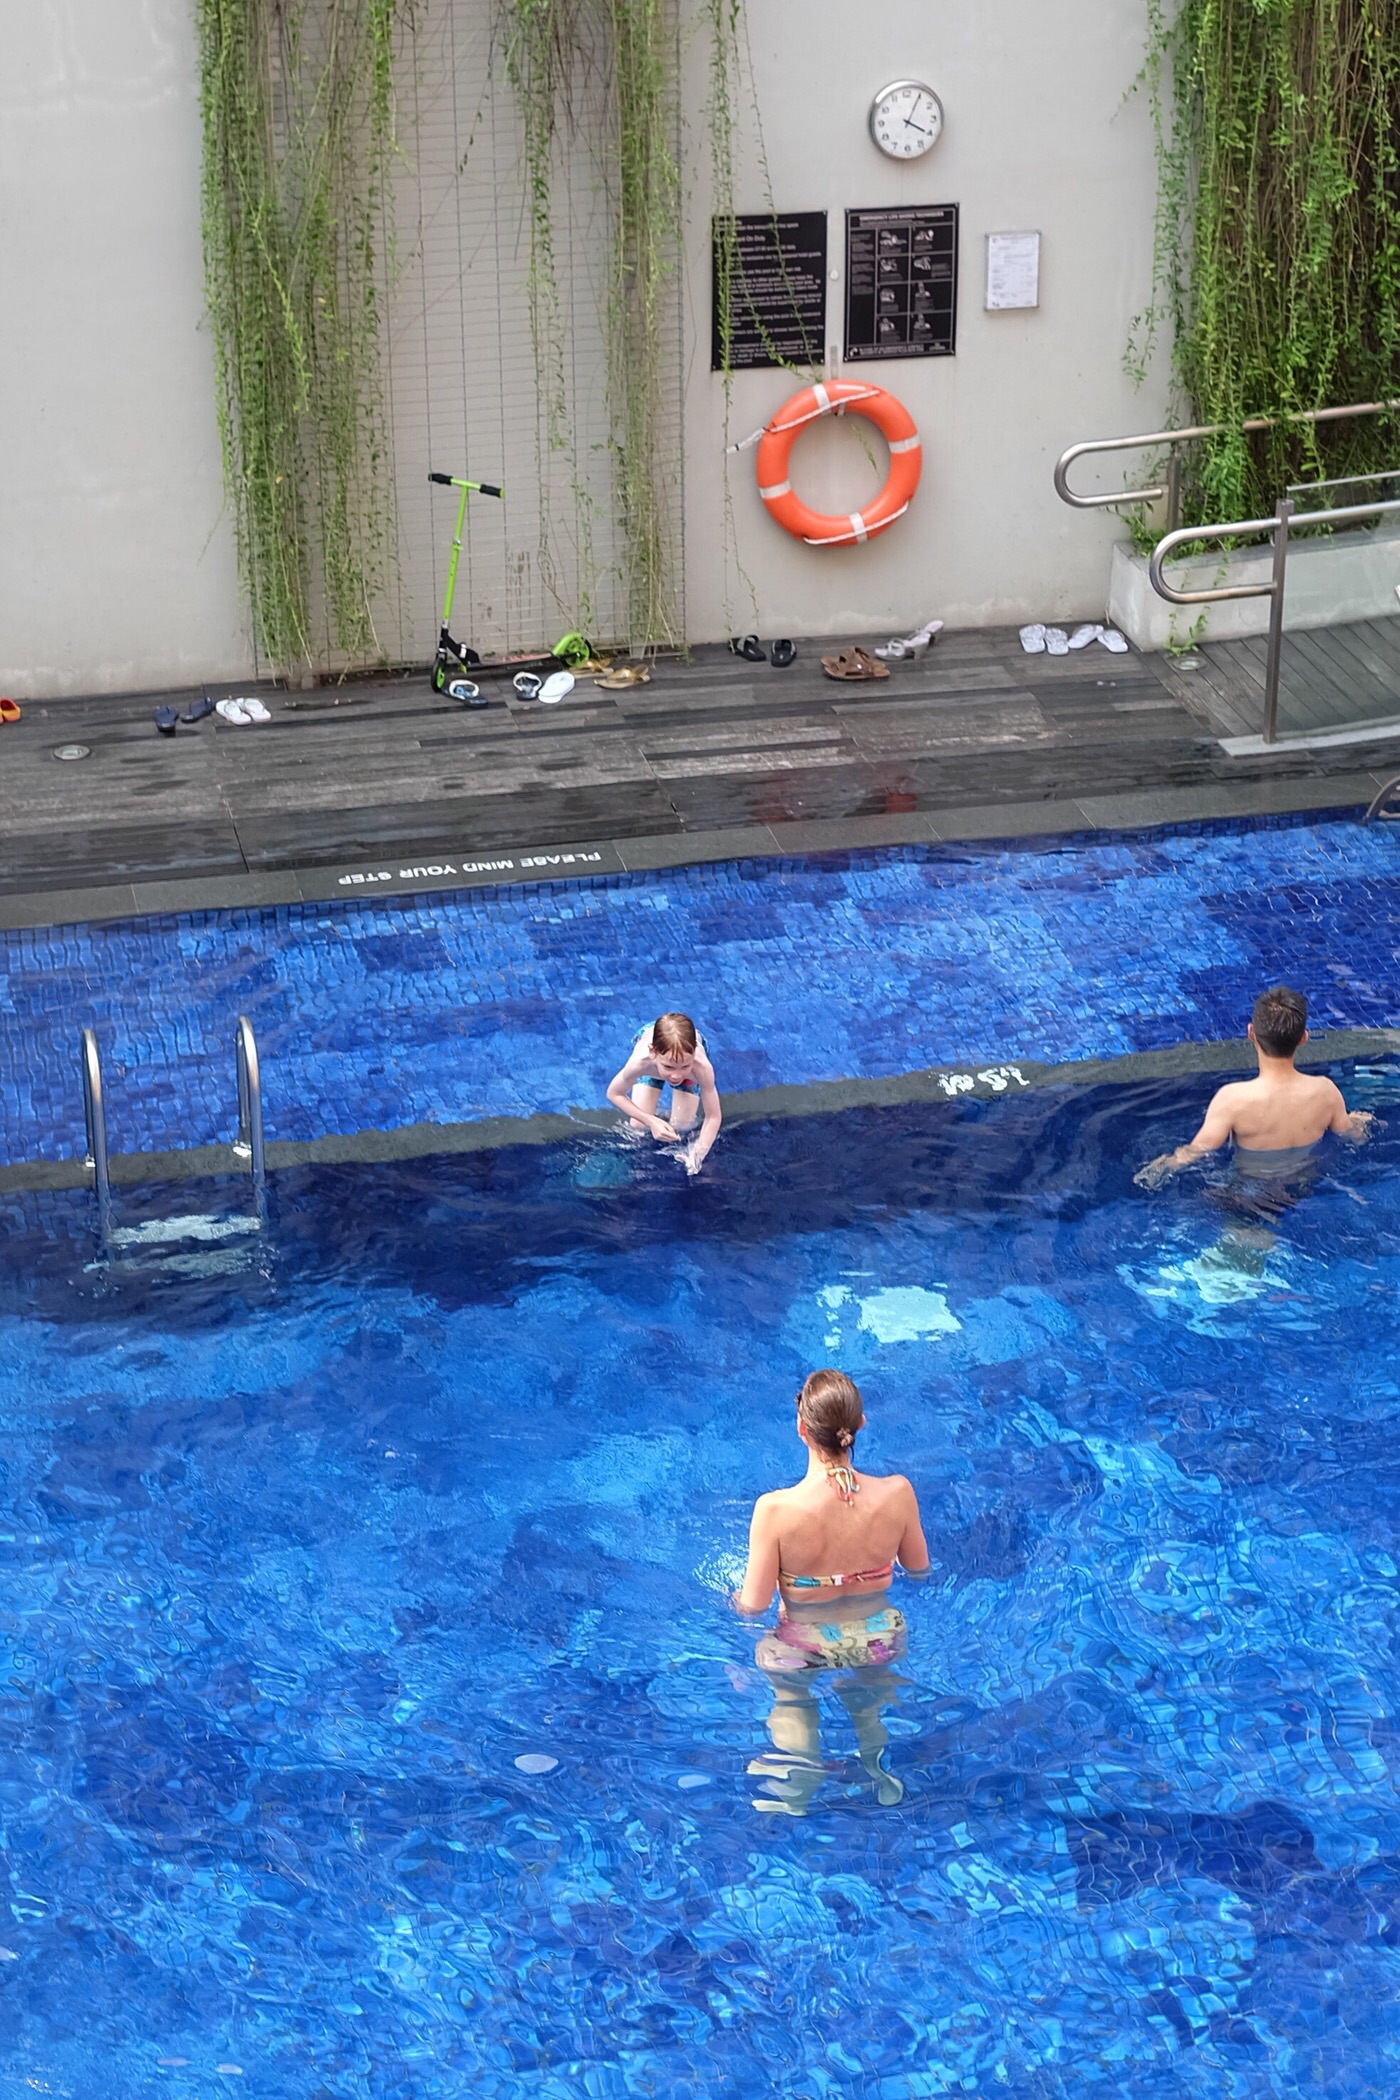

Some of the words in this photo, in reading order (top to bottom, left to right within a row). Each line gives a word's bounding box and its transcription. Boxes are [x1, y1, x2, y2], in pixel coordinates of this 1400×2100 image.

[462, 859, 514, 873] MIND
[520, 851, 602, 868] PLEASE
[338, 870, 392, 886] STEP
[399, 865, 458, 880] YOUR
